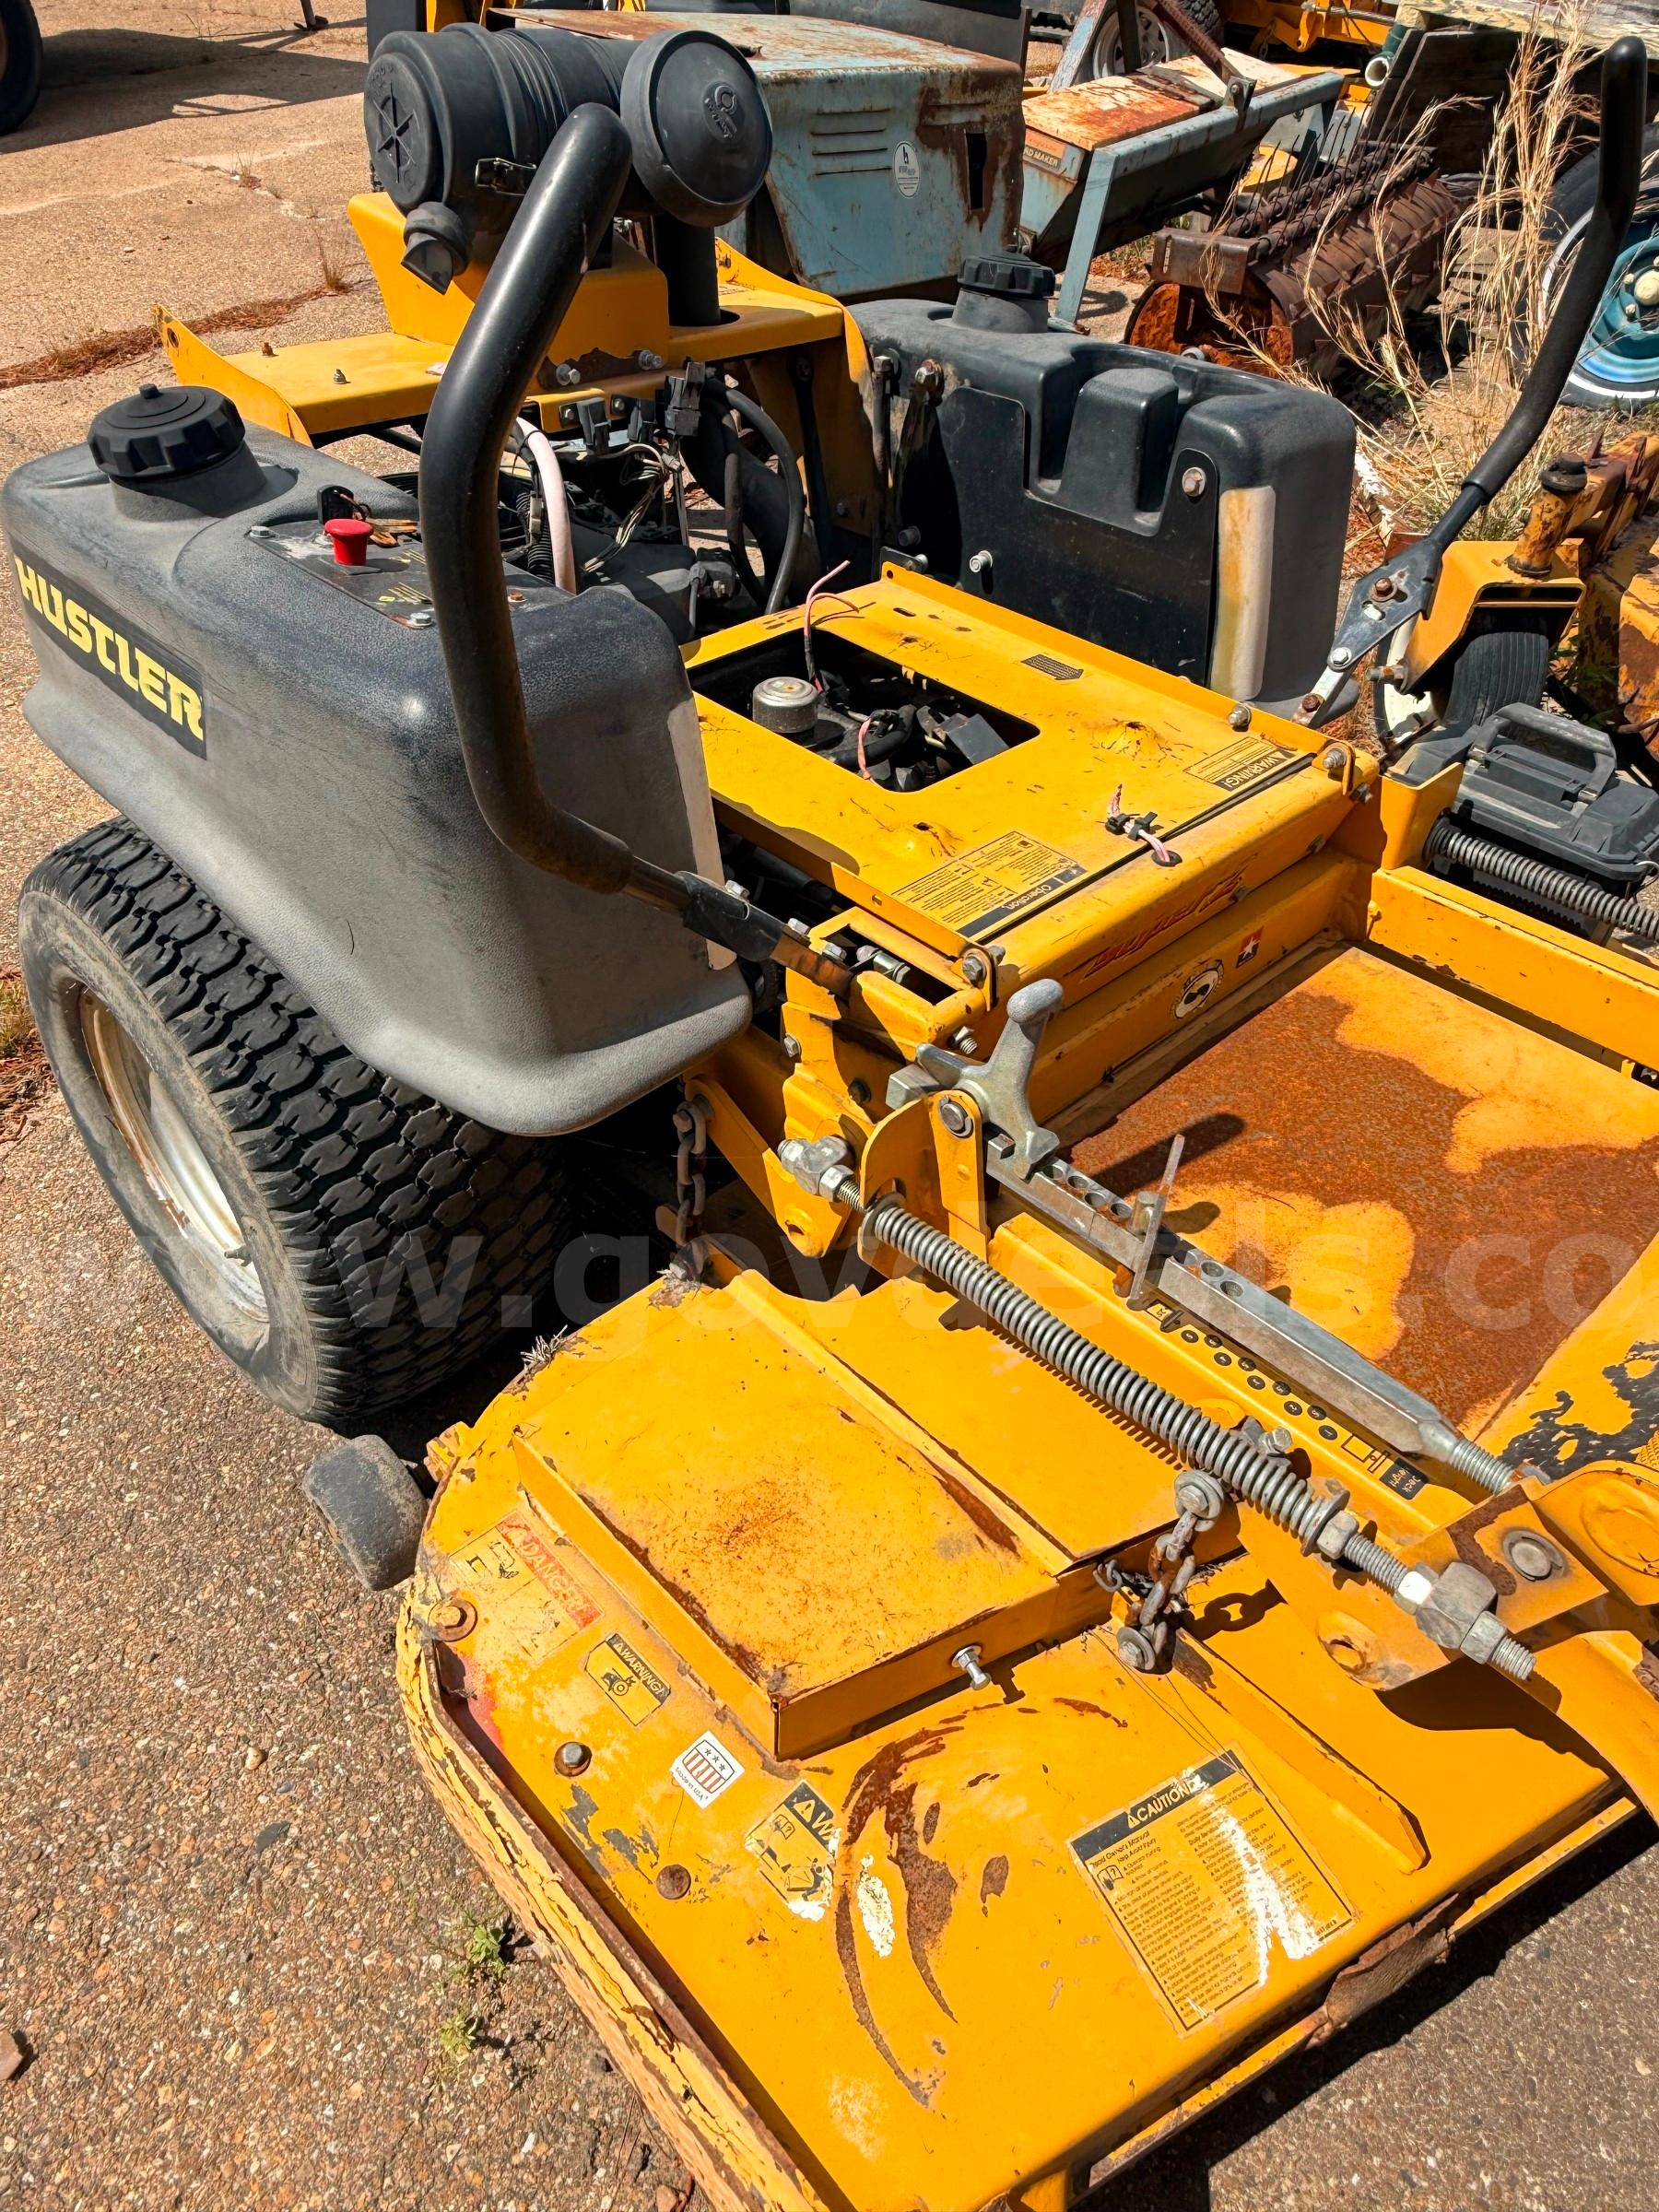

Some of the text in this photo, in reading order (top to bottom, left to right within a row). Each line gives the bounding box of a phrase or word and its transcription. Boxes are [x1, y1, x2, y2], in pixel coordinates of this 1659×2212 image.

[14, 554, 203, 741] HUSTLER
[1220, 757, 1278, 788] WARNING!
[620, 1646, 665, 1694] WARNING!
